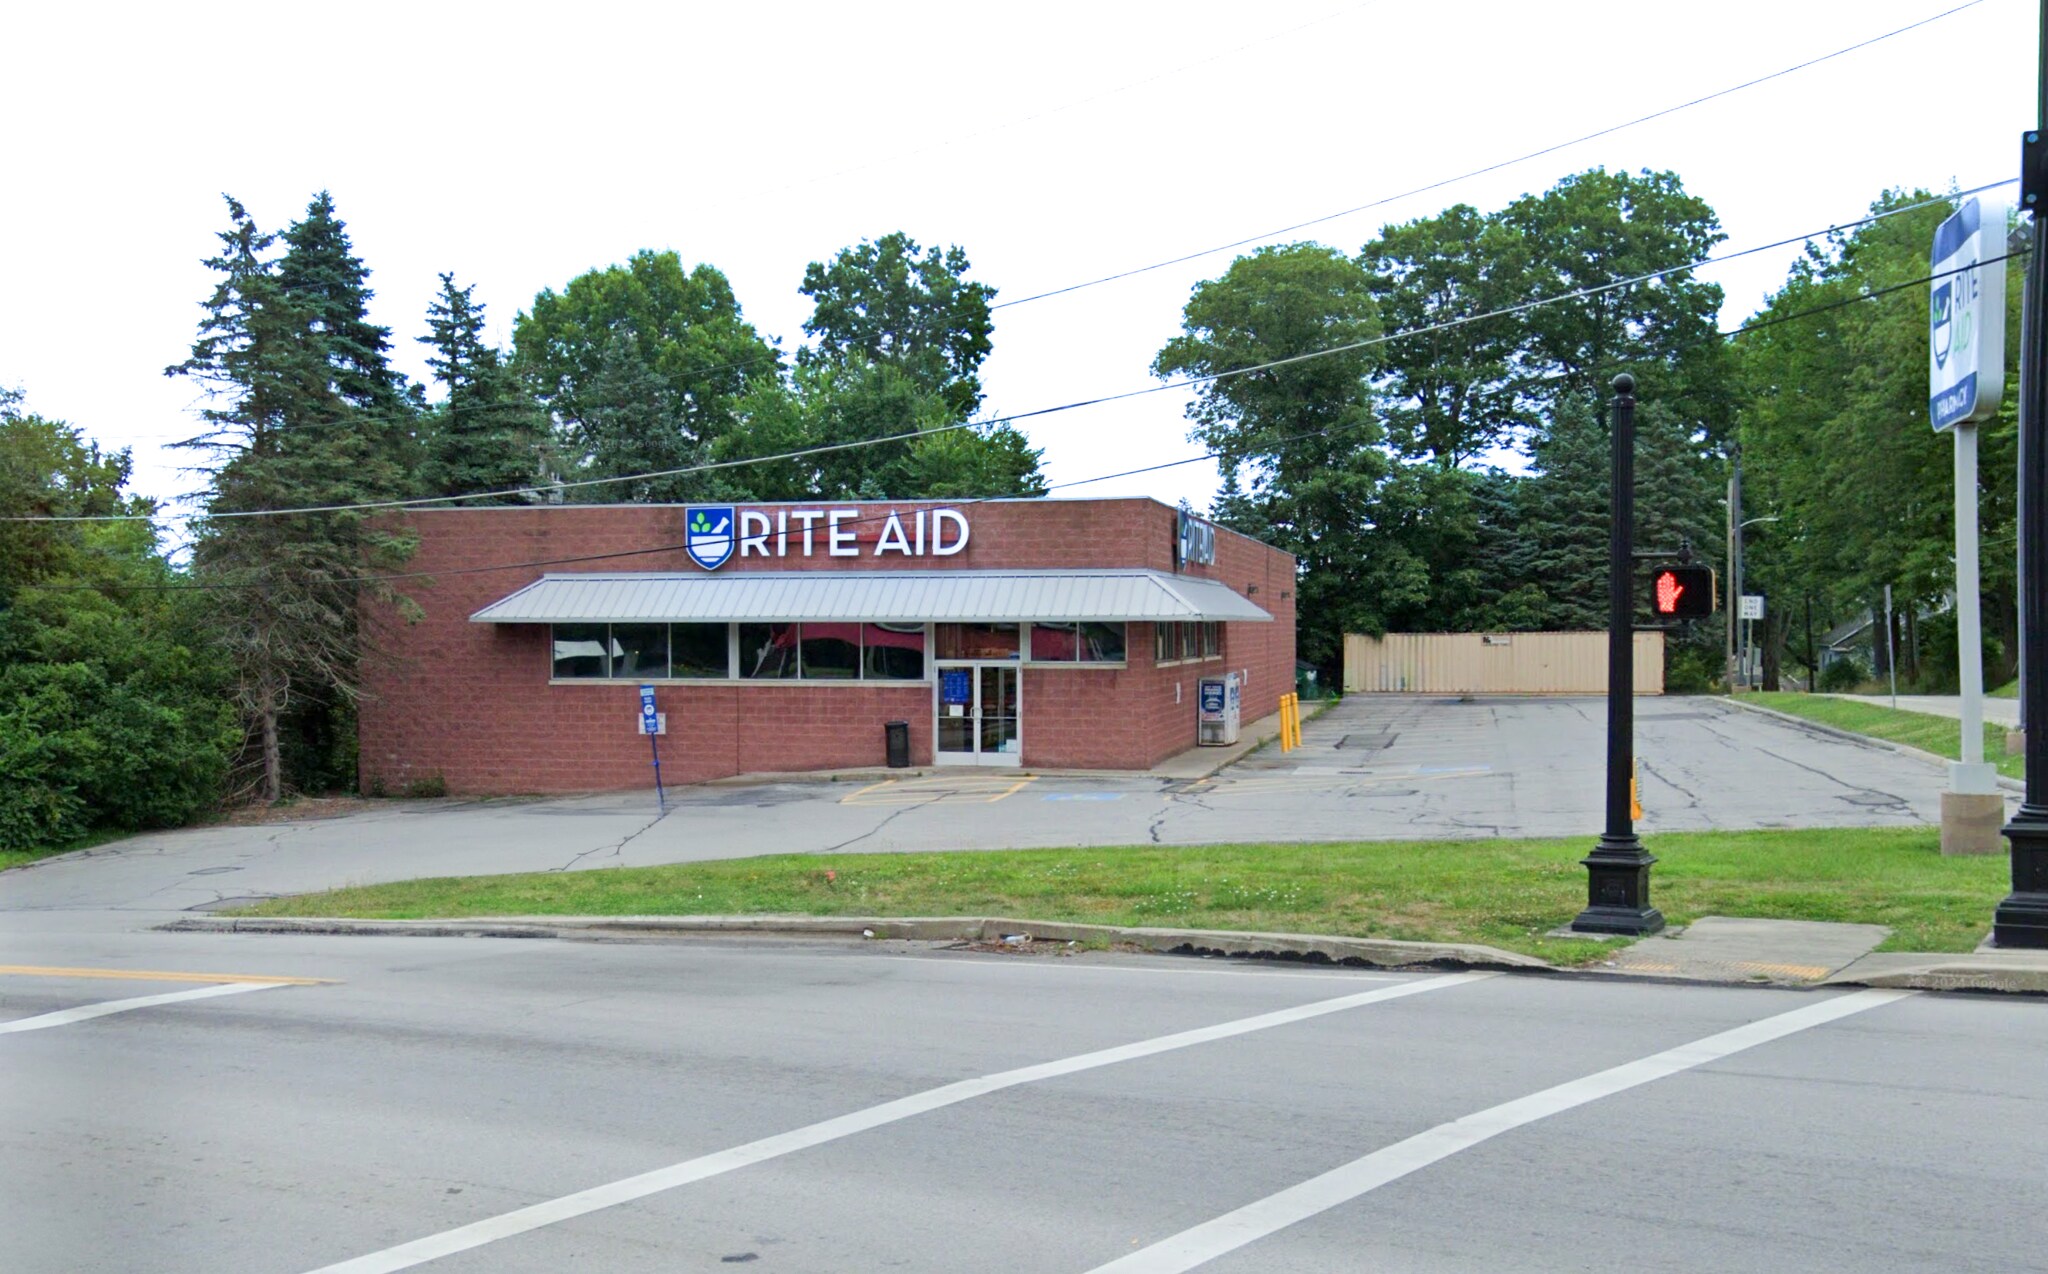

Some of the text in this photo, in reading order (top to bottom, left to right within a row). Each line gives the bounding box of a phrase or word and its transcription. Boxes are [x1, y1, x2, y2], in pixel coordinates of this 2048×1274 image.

[1955, 258, 1978, 313] RITE
[1953, 310, 1972, 352] AID
[741, 509, 970, 557] RITE AID
